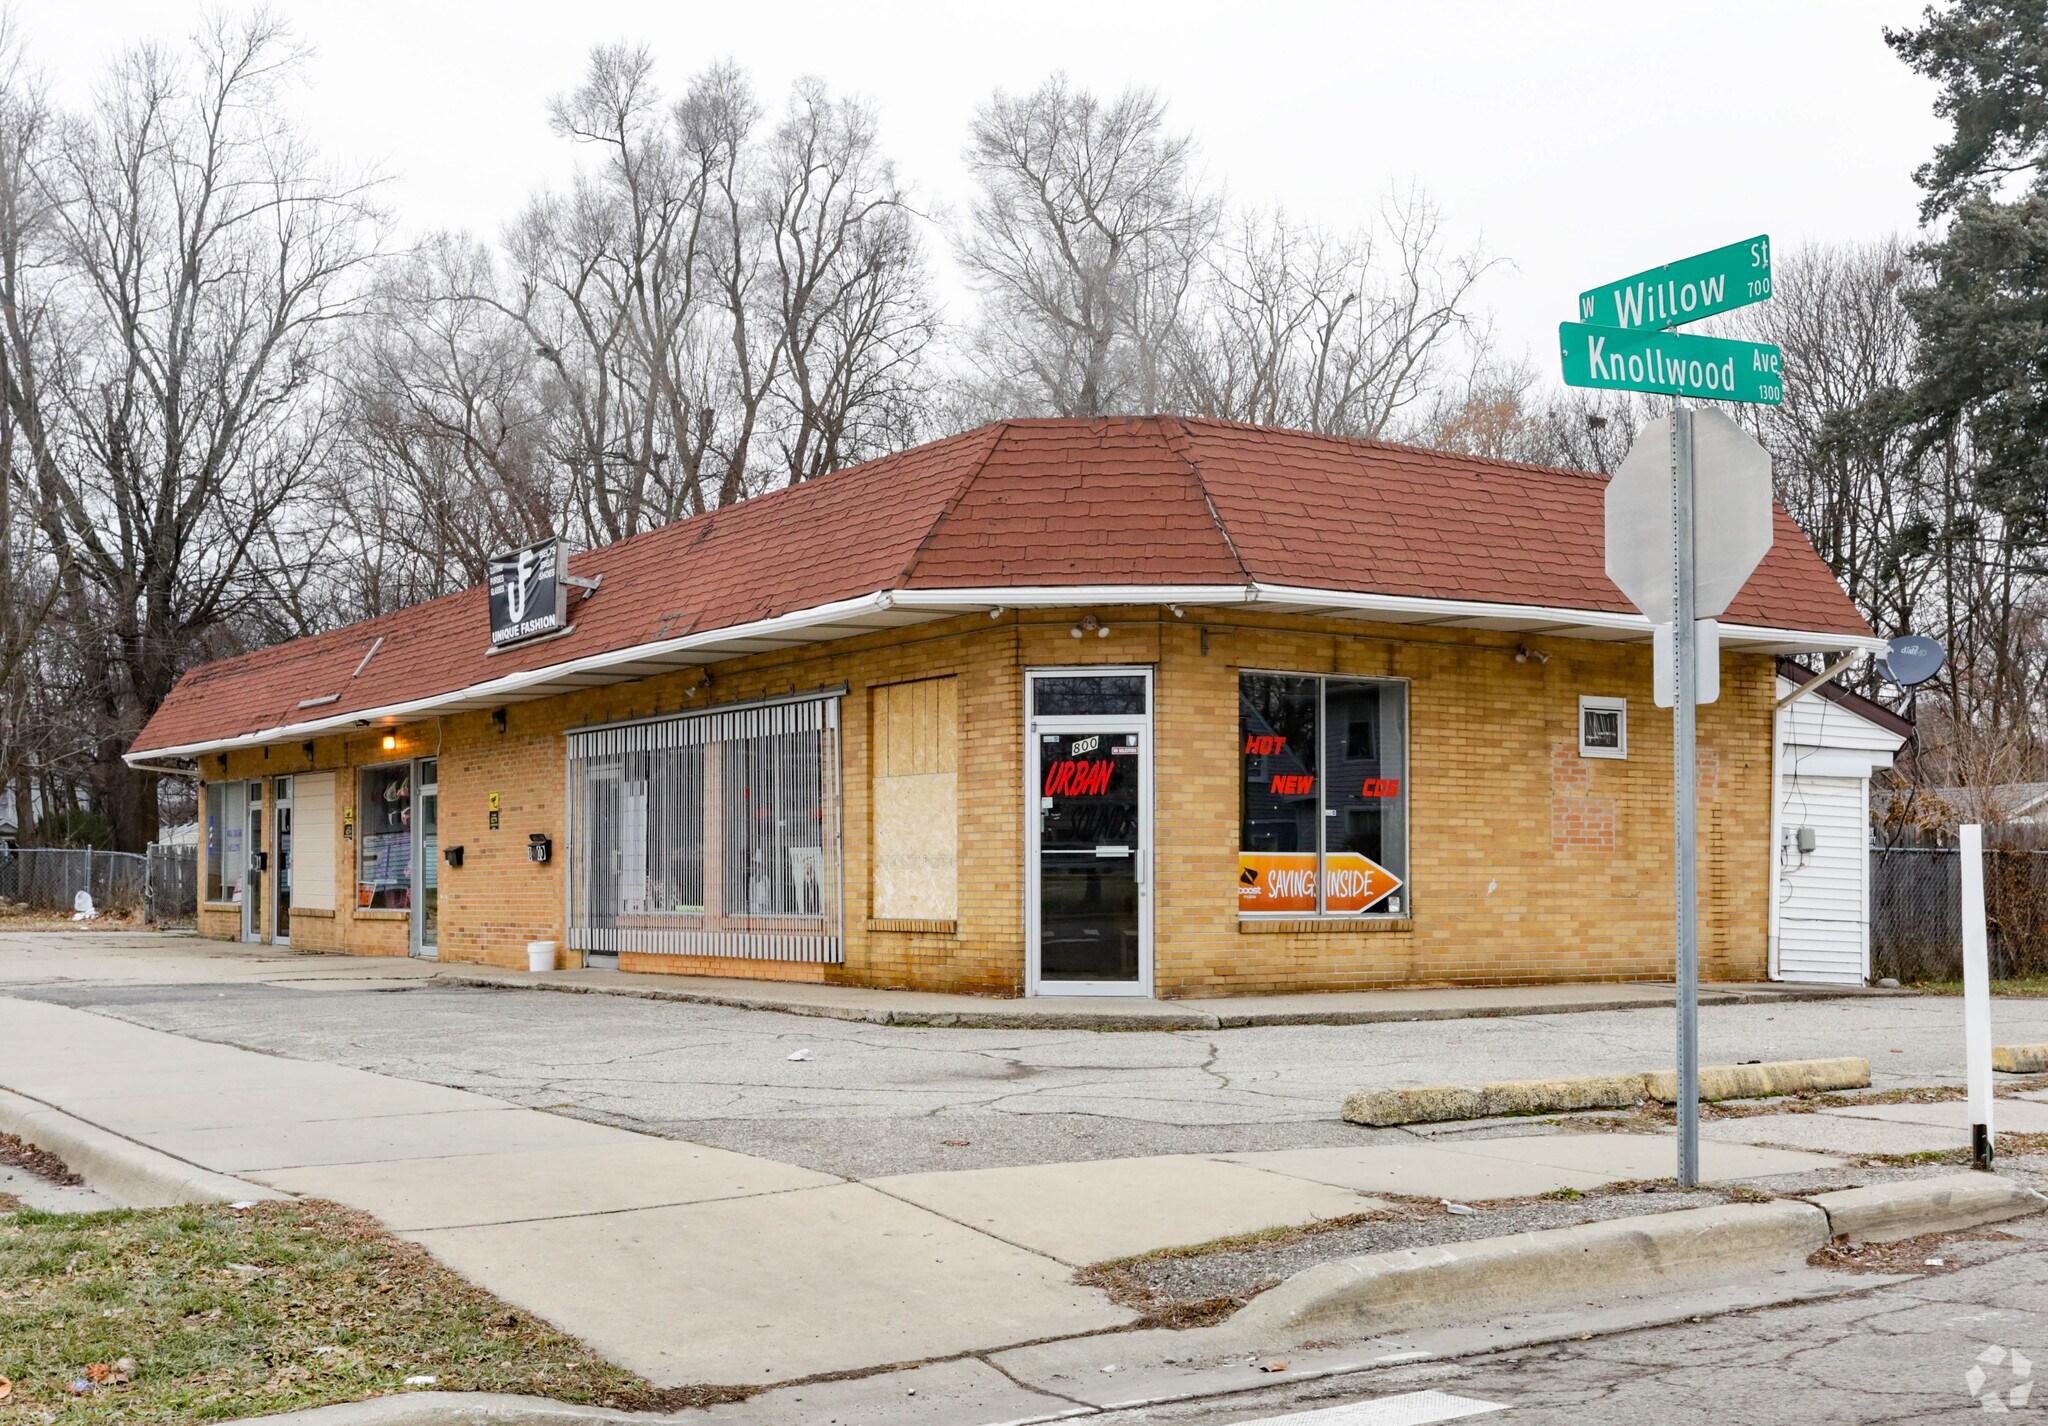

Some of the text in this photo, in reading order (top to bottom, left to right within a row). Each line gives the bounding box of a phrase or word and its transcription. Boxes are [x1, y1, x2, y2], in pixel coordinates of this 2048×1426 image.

[1582, 240, 1769, 329] W Willow St
[1748, 277, 1770, 298] 700
[1588, 335, 1778, 391] Knollwood Ave
[1759, 384, 1780, 401] 1300
[492, 613, 555, 643] UNIQUE FASHION
[1073, 737, 1098, 754] 800
[1245, 736, 1286, 755] HOT
[1044, 760, 1115, 796] URBAN
[1270, 775, 1314, 795] NEW
[1362, 778, 1399, 797] CDS
[1327, 869, 1374, 898] INSIDE
